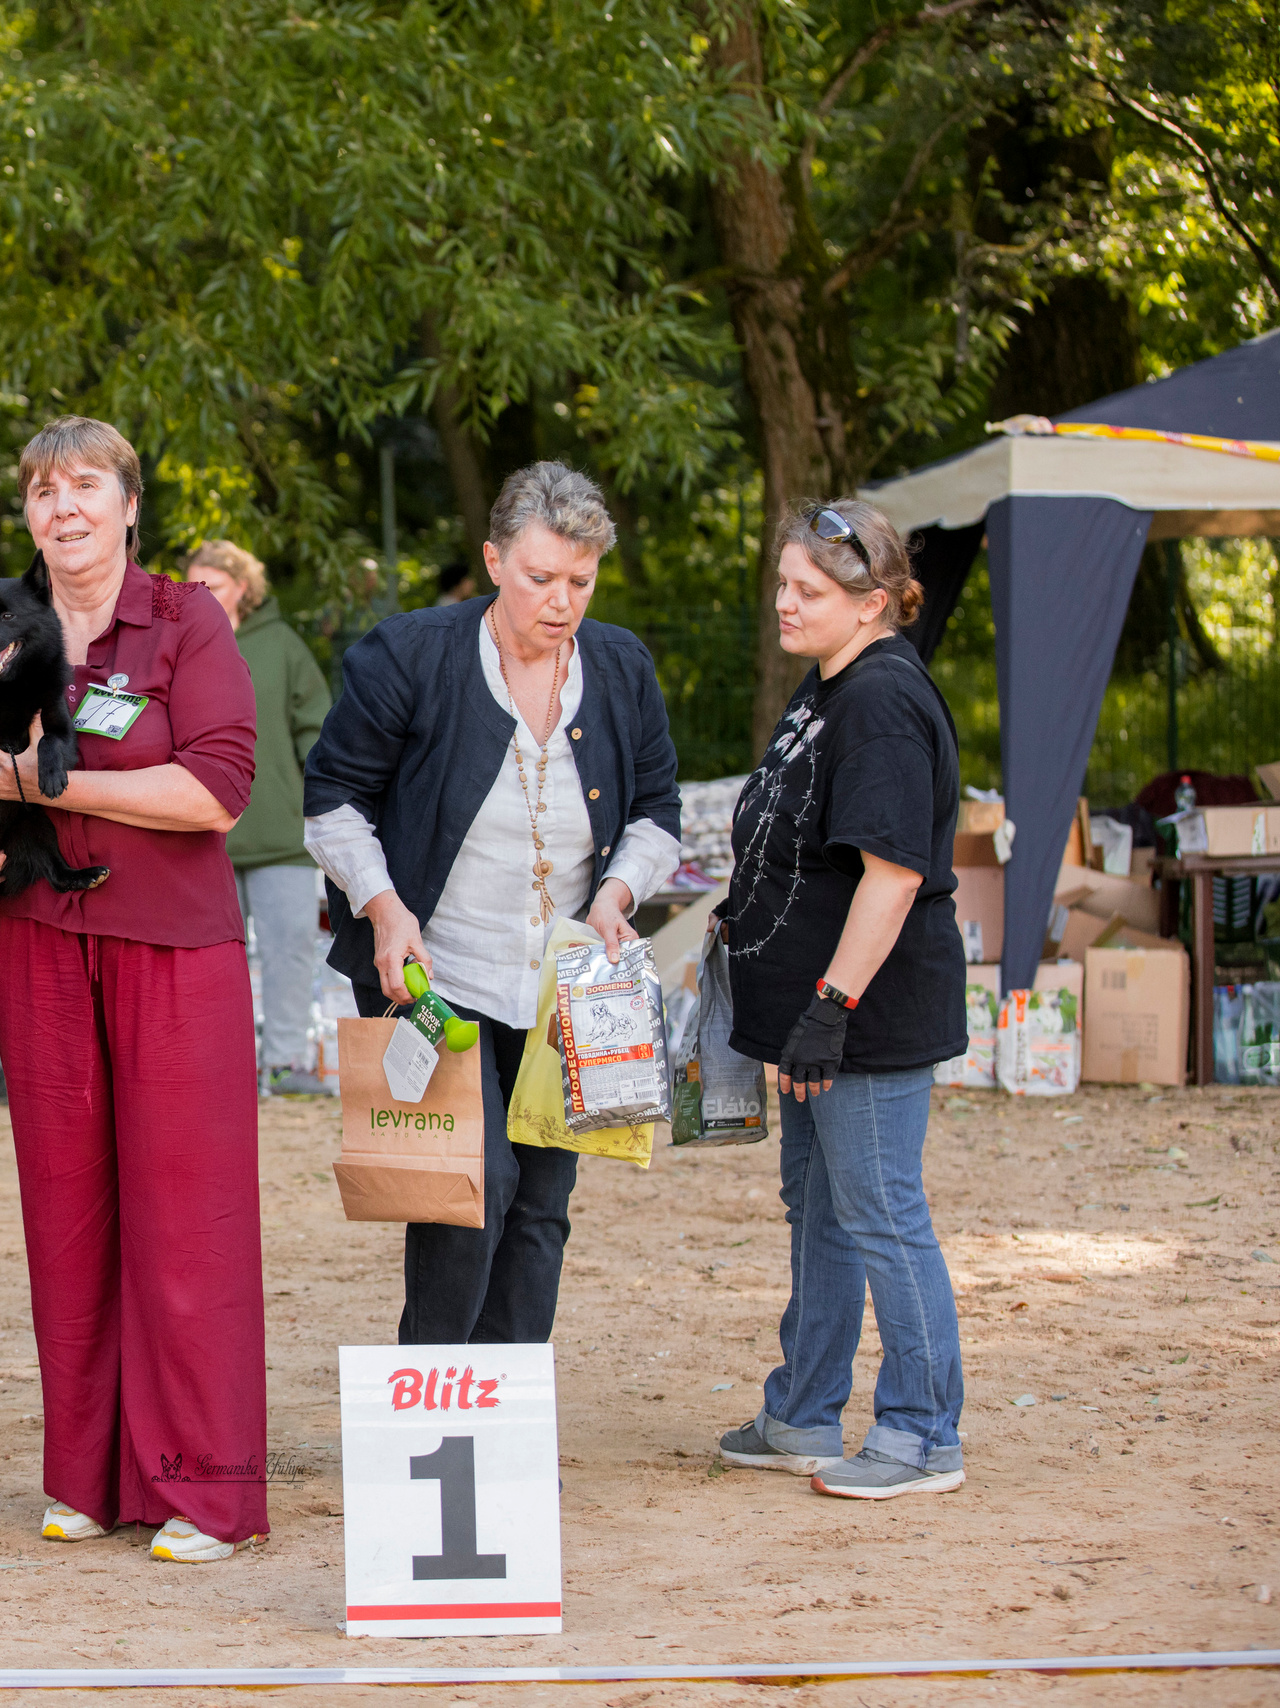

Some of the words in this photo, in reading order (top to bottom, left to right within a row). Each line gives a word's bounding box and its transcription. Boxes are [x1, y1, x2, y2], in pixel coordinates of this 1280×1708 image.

[586, 981, 633, 995] ЗООМЕНЮ
[558, 985, 584, 1112] ПРОФЕССИОНАЛ
[579, 1055, 622, 1068] СУПЕРМЯСО
[370, 1107, 455, 1132] levrana
[704, 1096, 761, 1119] Eláto
[371, 1131, 452, 1140] NATURAL
[387, 1365, 502, 1412] Blitz
[409, 1436, 507, 1580] 1
